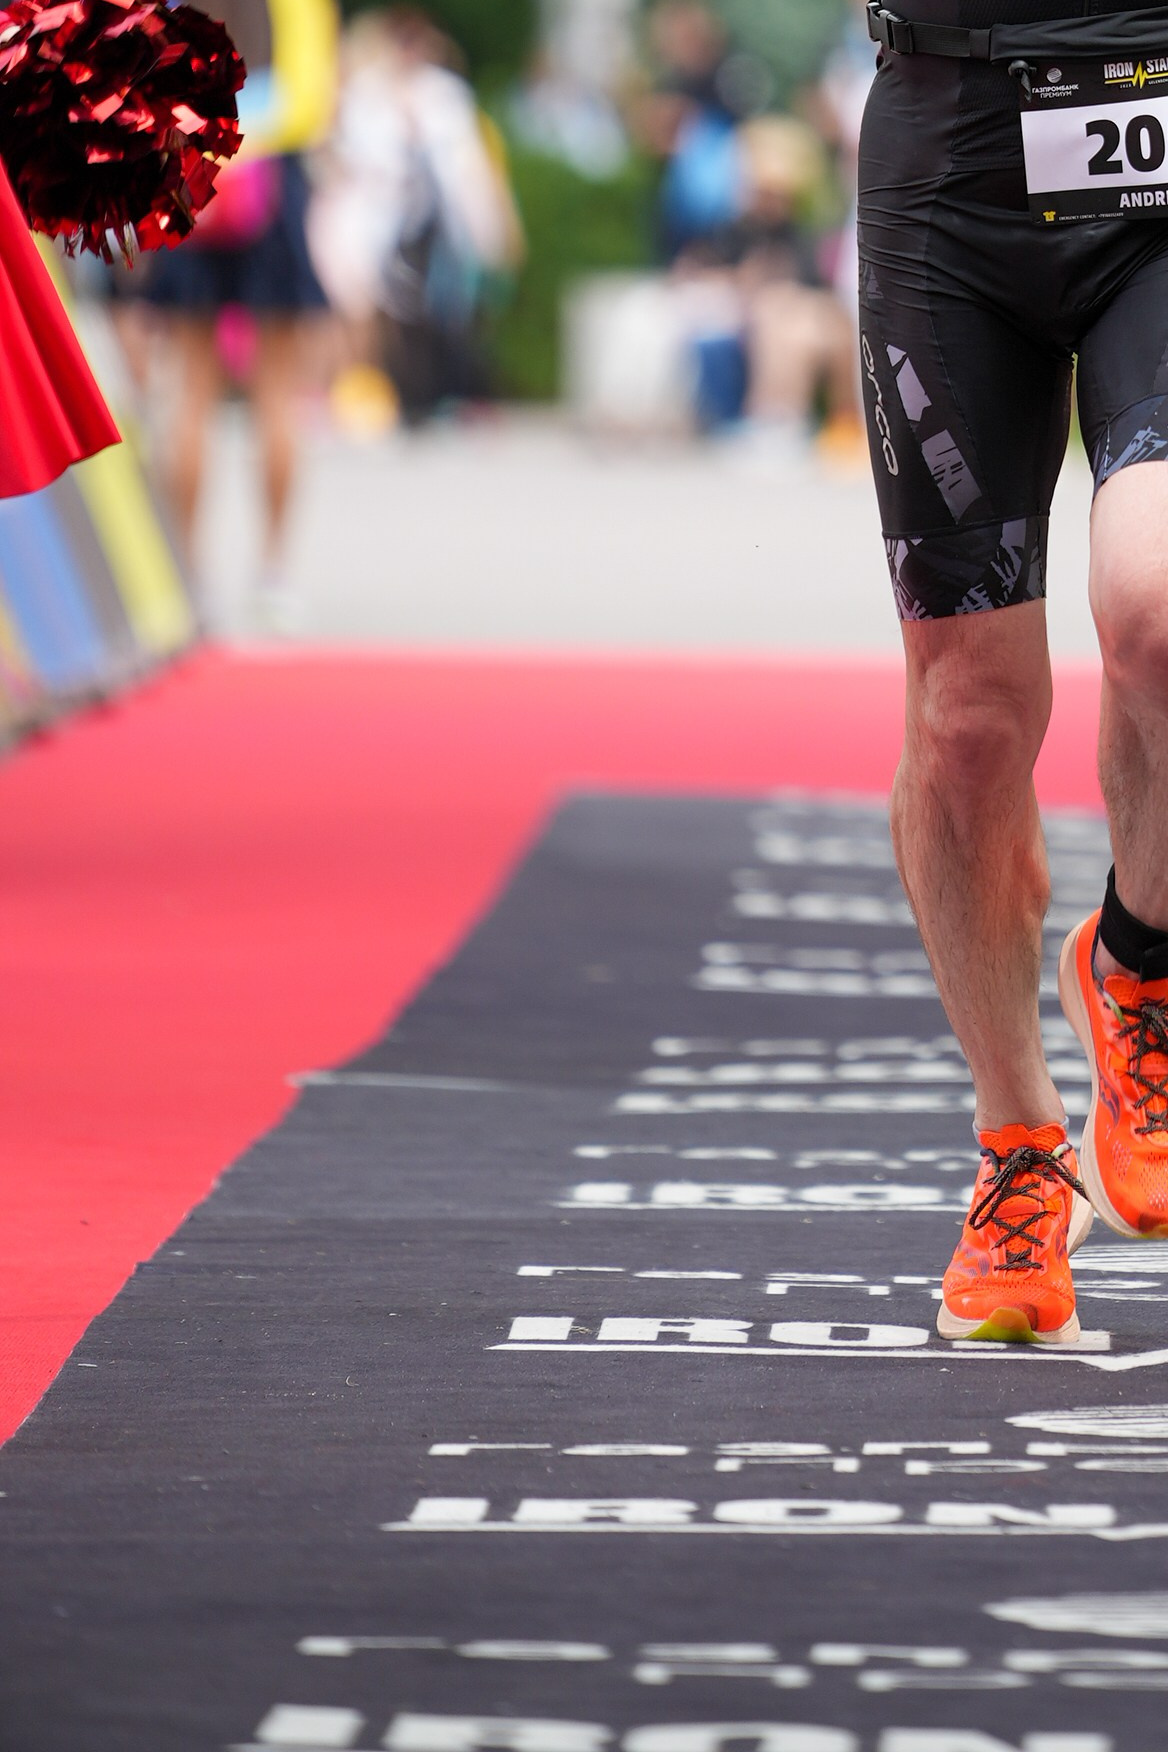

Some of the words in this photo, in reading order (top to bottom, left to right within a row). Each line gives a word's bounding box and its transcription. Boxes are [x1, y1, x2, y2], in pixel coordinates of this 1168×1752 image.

[1103, 62, 1134, 79] IRON
[1031, 83, 1079, 94] ГАЗПРОМБАНК
[1040, 90, 1072, 99] ПРЕМИУМ
[862, 334, 899, 477] orca
[573, 1182, 975, 1207] IRO
[406, 1497, 1114, 1527] IRON
